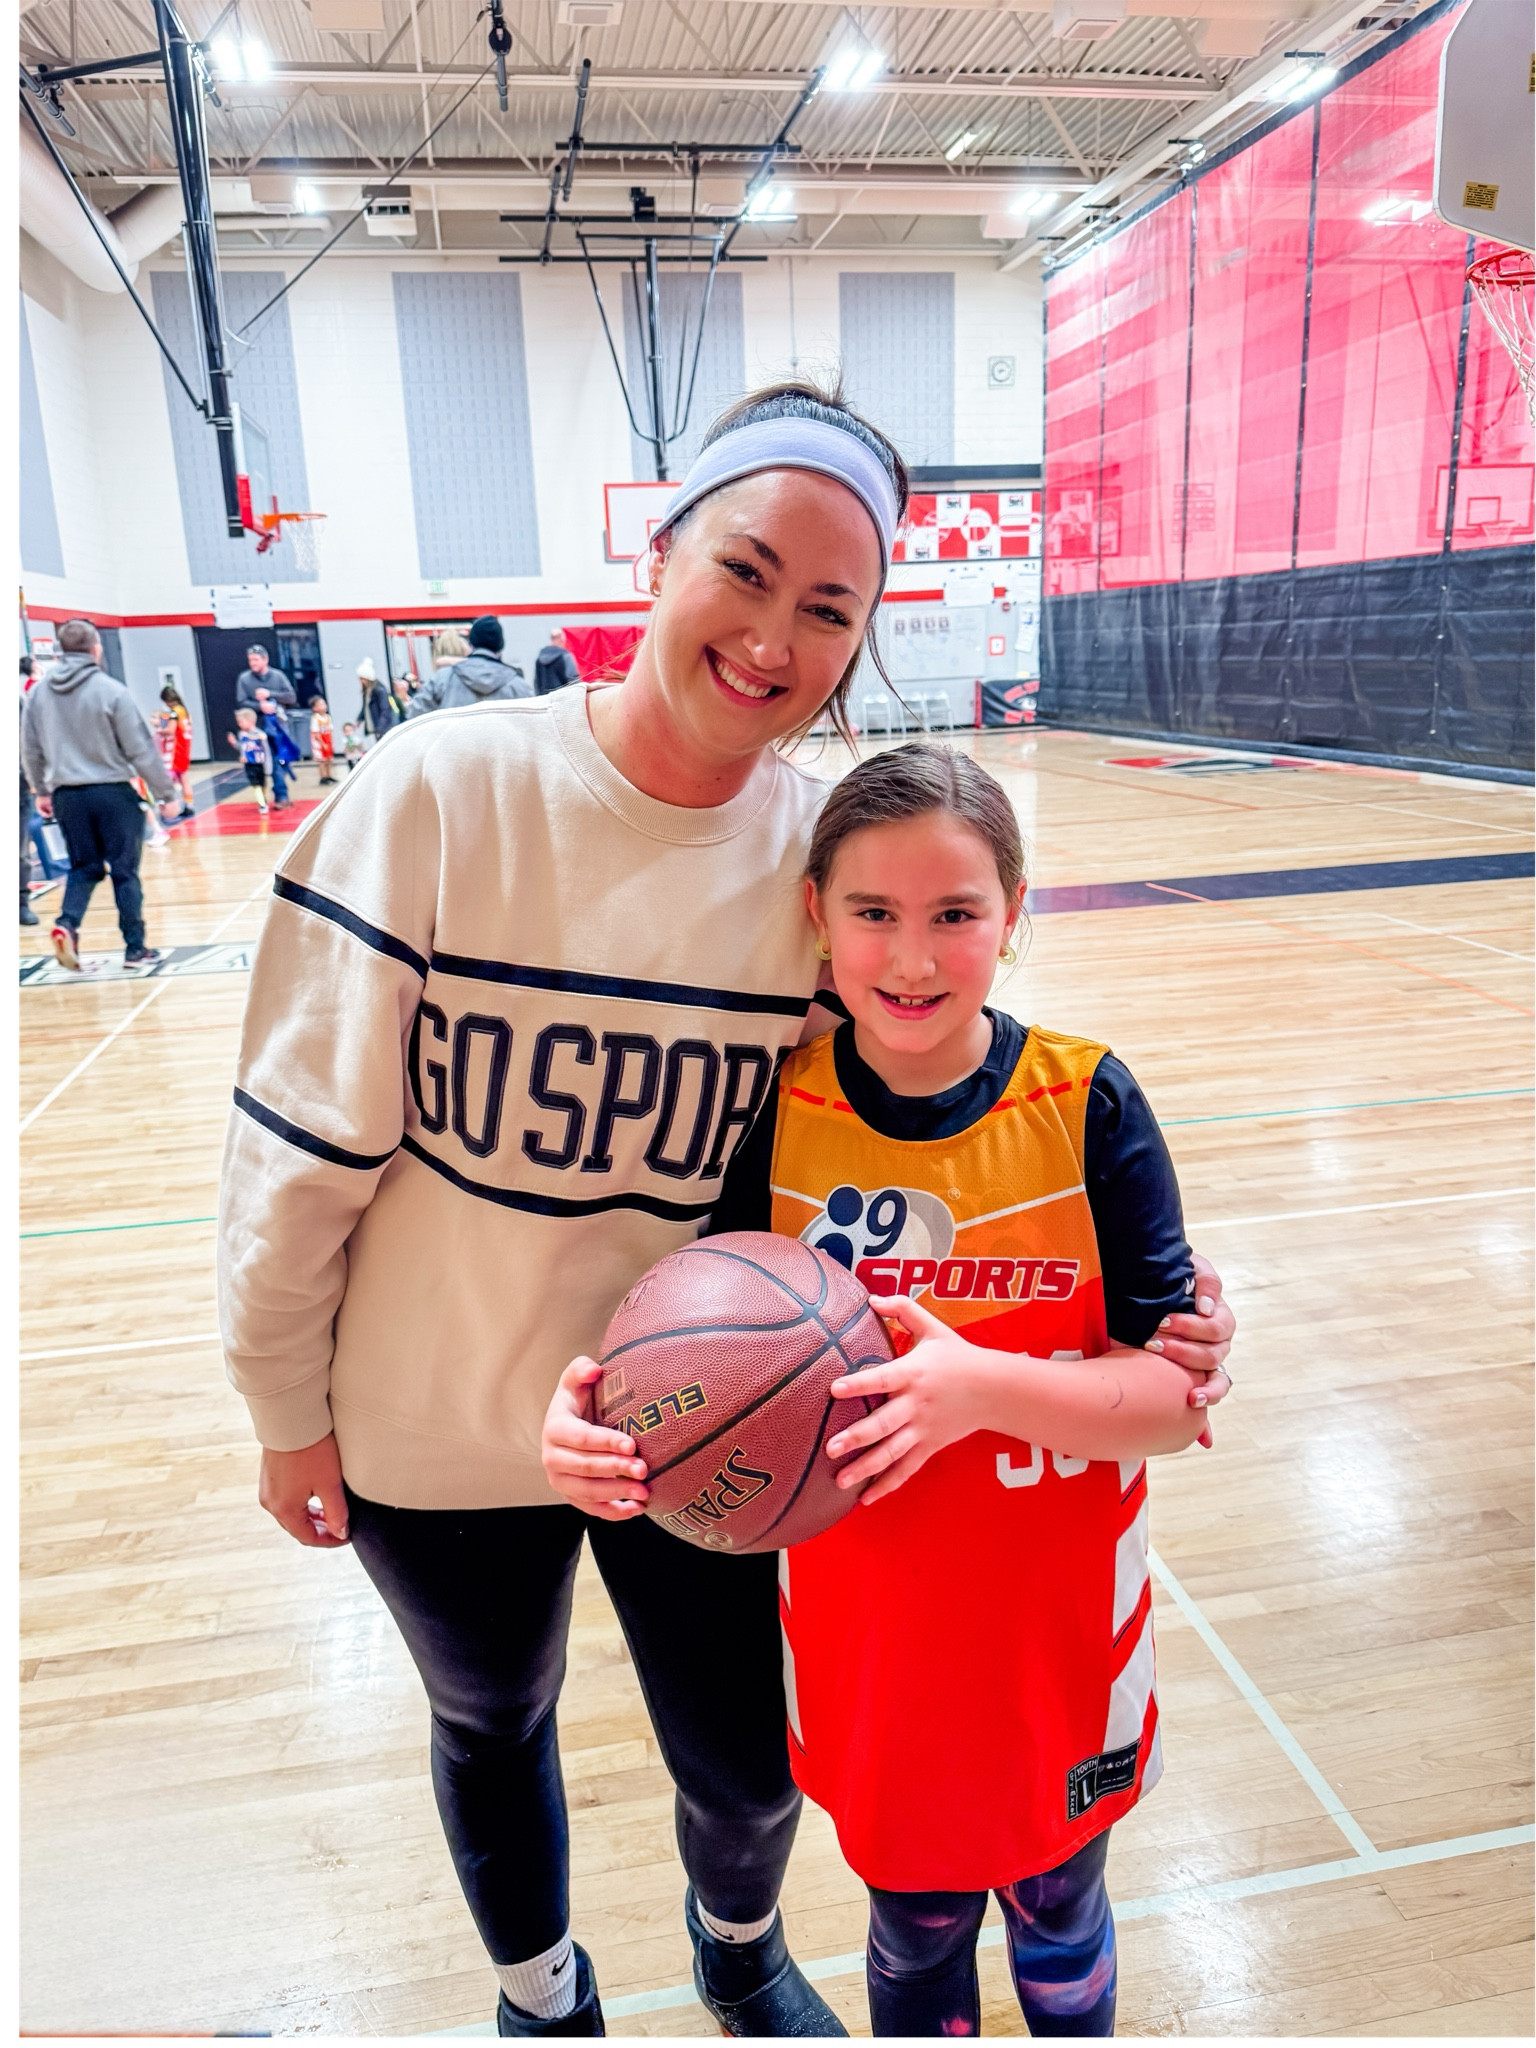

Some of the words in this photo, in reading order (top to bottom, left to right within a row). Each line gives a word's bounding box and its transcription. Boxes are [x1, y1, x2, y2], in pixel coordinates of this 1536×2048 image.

[407, 1000, 513, 1159] GO
[521, 1022, 796, 1181] SPOR
[855, 1257, 1081, 1301] SPORTS
[612, 1380, 709, 1436] ELEV
[655, 1445, 775, 1538] SPALD
[1076, 1760, 1097, 1776] YOUTH
[1082, 1779, 1092, 1806] L
